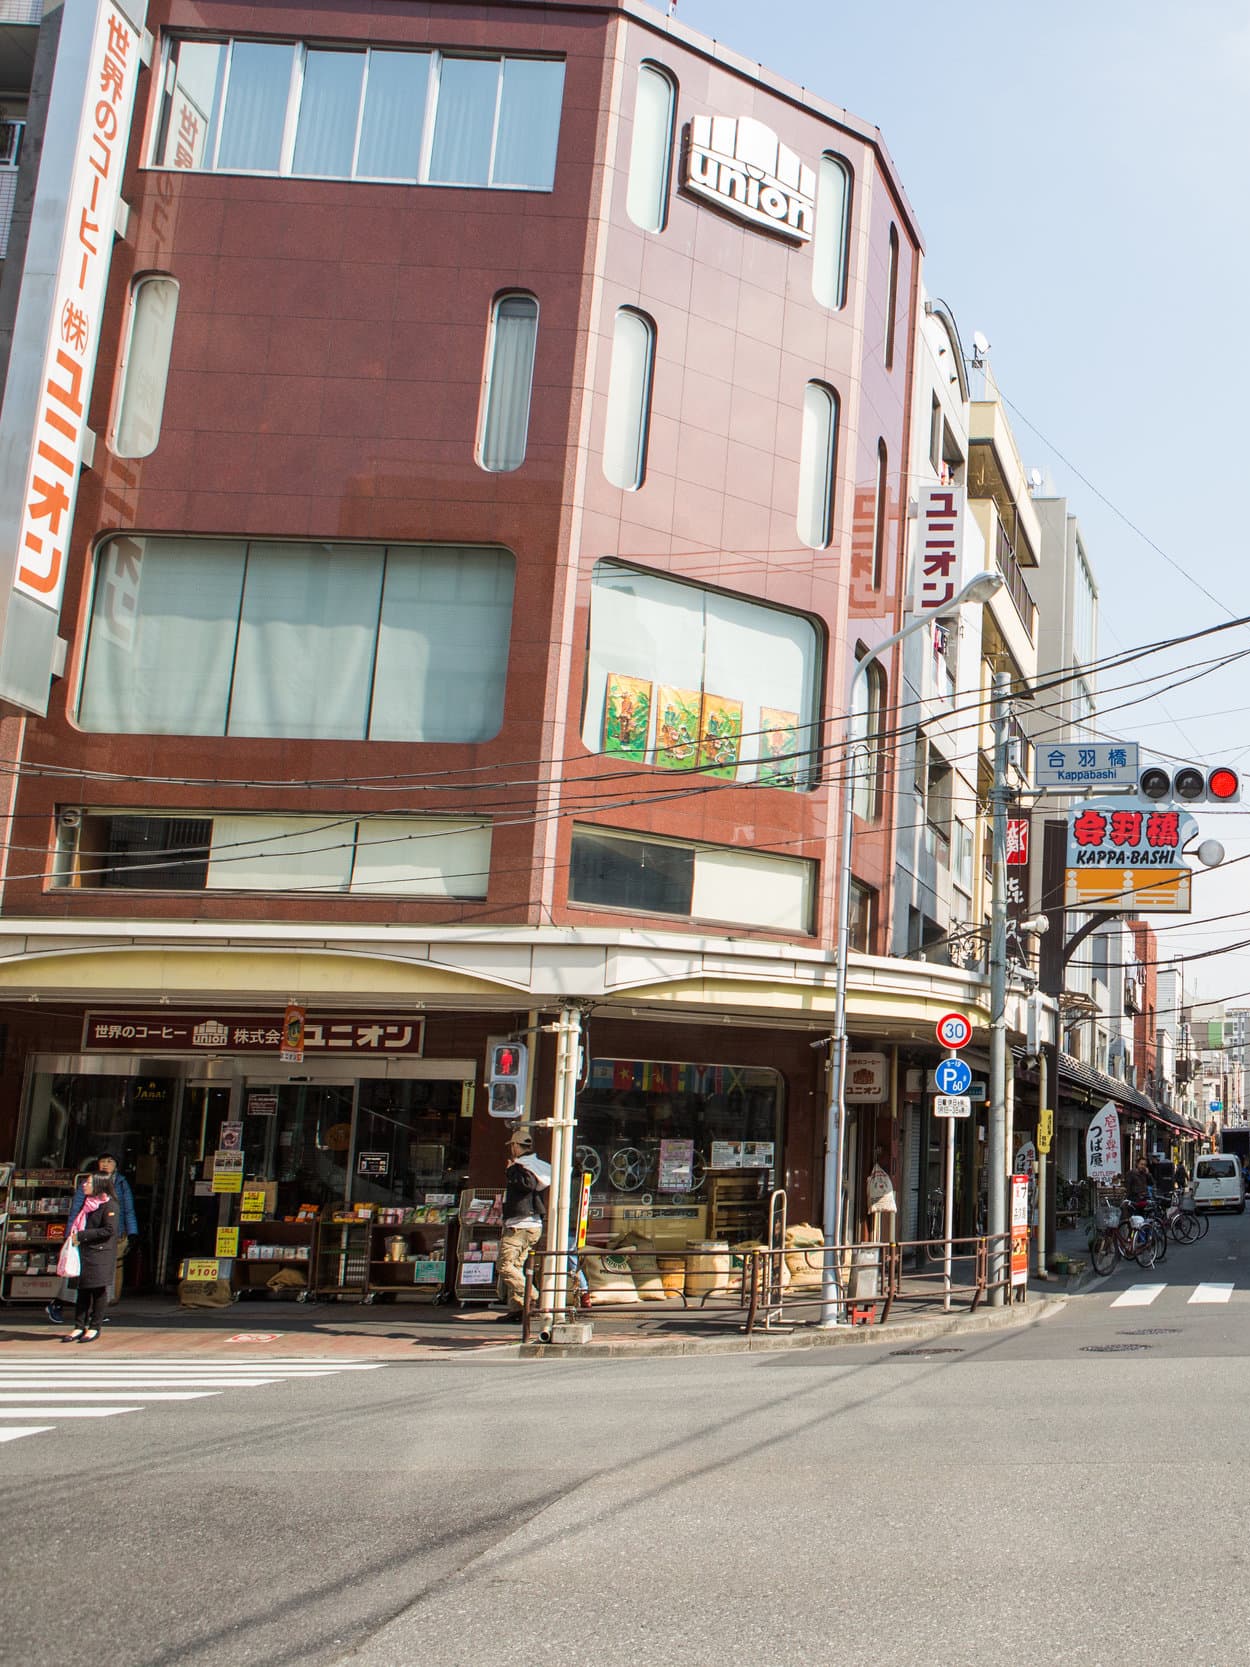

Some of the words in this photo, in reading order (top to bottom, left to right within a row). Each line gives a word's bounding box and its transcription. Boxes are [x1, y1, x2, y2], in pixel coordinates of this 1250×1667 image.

[690, 148, 814, 234] union
[922, 491, 959, 609] ユニオン
[1047, 748, 1127, 768] 合羽橋
[1058, 769, 1117, 781] Kappabashi
[1074, 809, 1180, 847] 合羽橋
[95, 1024, 187, 1039] 世界のコーヒー
[192, 1033, 228, 1044] union
[234, 1028, 284, 1044] 株式会
[303, 1025, 413, 1048] ユニオン
[945, 1023, 964, 1039] 30
[944, 1068, 957, 1090] P
[952, 1080, 963, 1091] 60
[846, 1086, 881, 1095] ユニオン
[1090, 1126, 1103, 1167] つば屋
[189, 1268, 217, 1276] ¥100
